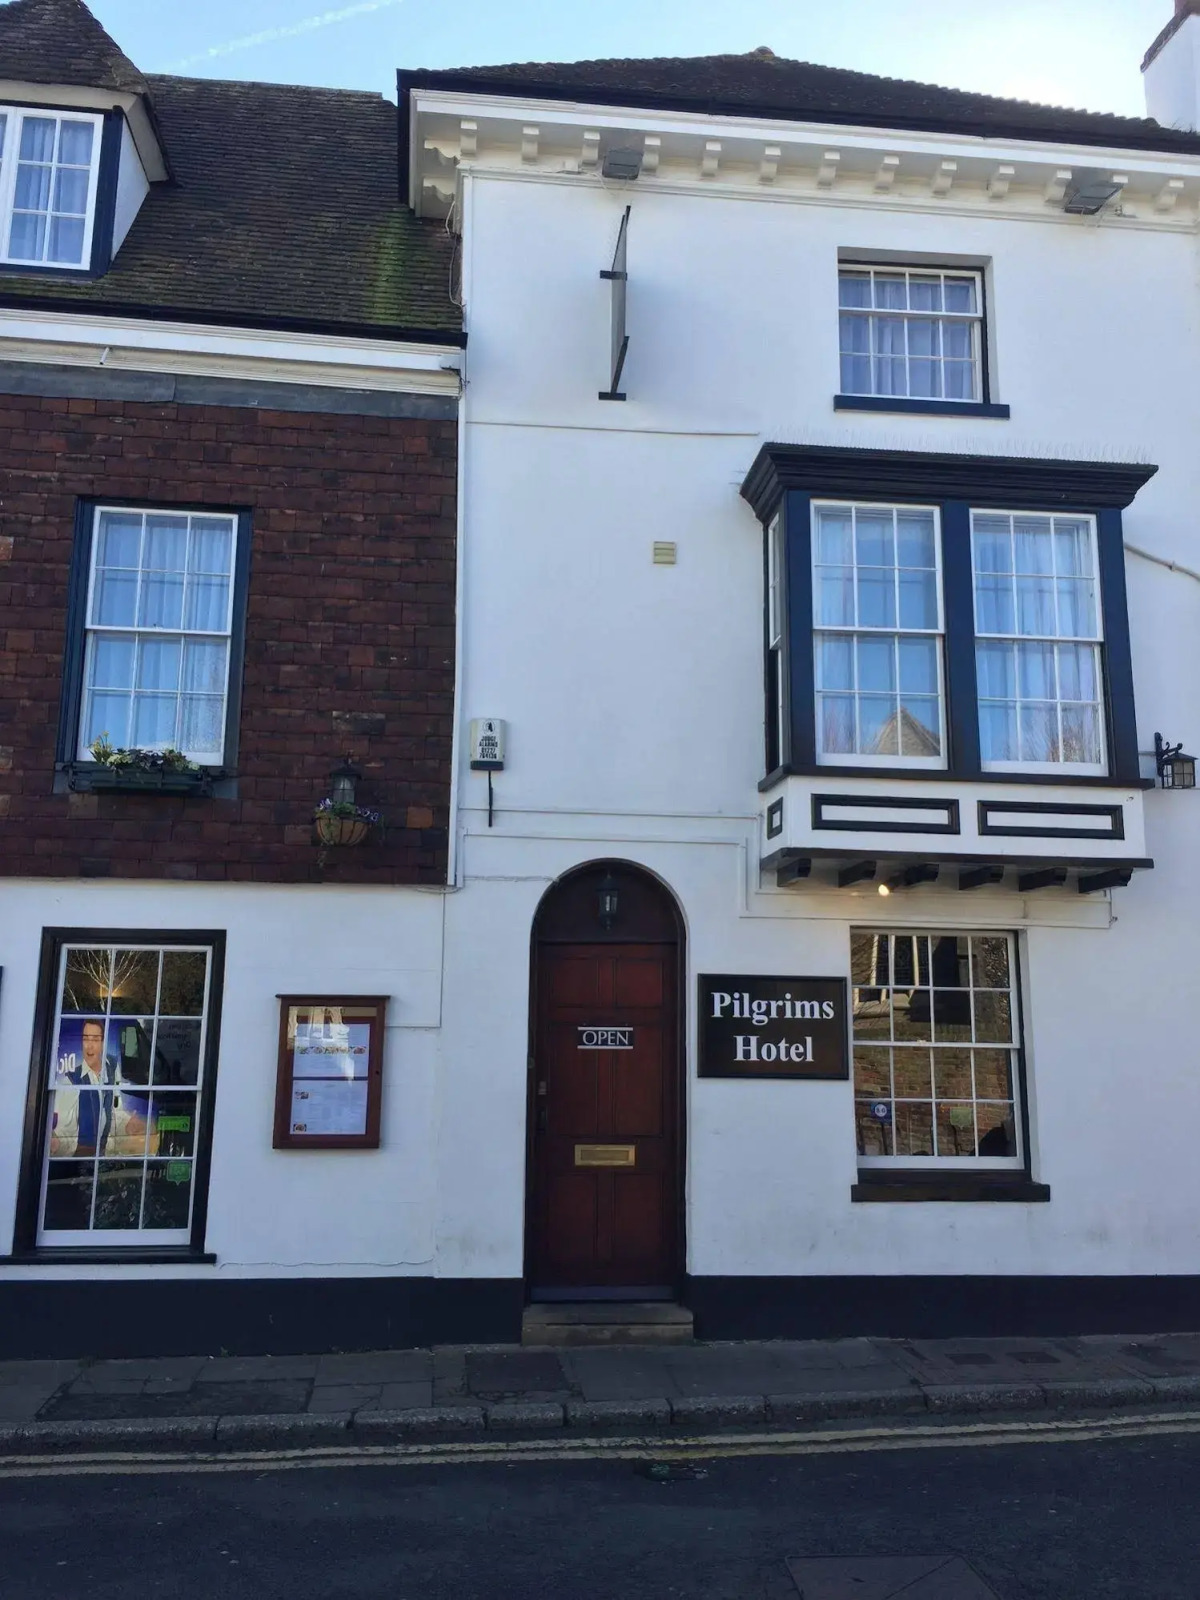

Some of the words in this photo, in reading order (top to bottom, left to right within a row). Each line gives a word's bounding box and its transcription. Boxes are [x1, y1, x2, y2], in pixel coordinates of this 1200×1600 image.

[711, 991, 835, 1026] Pilgrims
[582, 1030, 629, 1046] OPEN
[733, 1035, 815, 1062] Hotel
